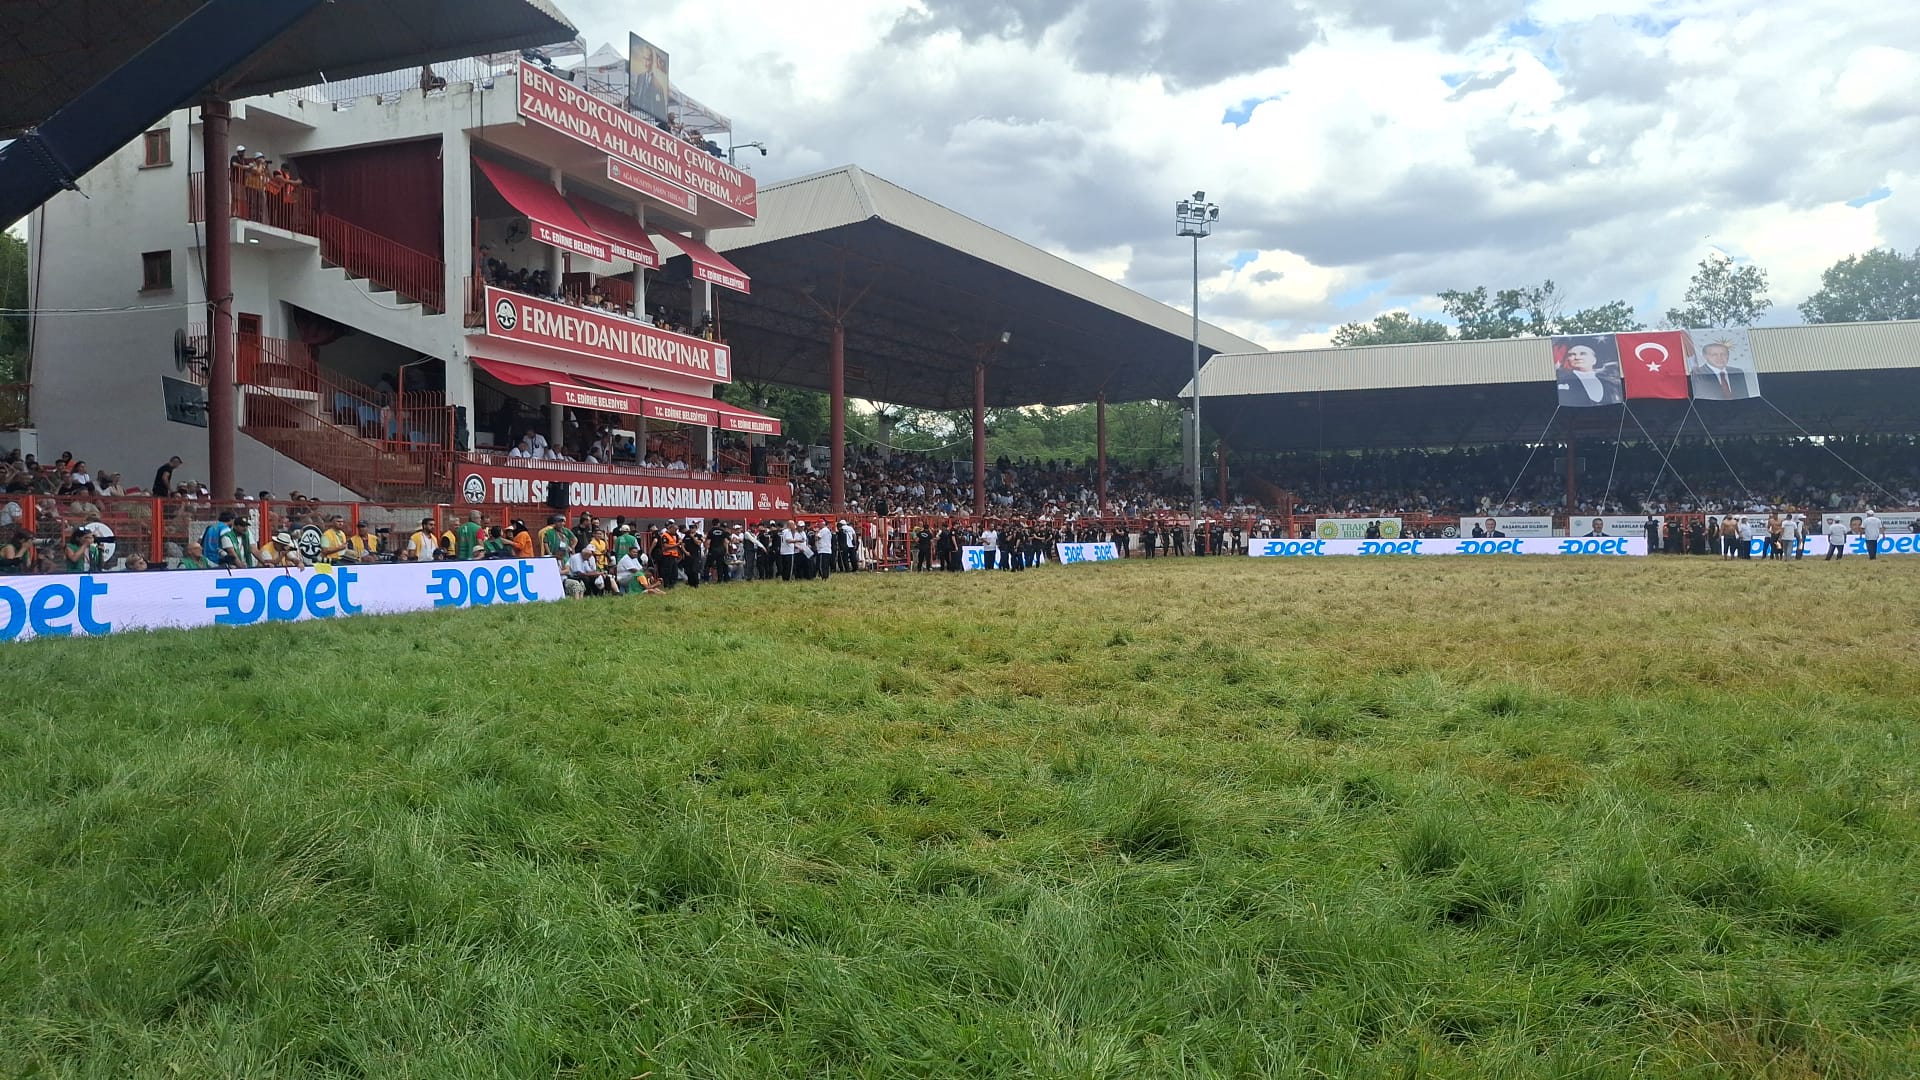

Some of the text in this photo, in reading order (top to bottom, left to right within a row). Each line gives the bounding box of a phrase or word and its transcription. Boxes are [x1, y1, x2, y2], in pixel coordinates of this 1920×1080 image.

[523, 67, 742, 188] BEN SPORCUNUN ZEKİ, ÇEVİK AYNI
[523, 93, 733, 204] ZAMANDA AHLAKLISINI SEVERİM.
[539, 227, 605, 258] T.C. EDİRNE BELEDİYESİ
[611, 243, 653, 266] DİRNE BELEDİYESİ
[522, 305, 710, 371] ERMEYDANI KIRKPINAR
[565, 391, 629, 411] T.C. EDİRNE BELEDİYESİ
[655, 406, 708, 424] T.C. EDİRNE BELEDİYESİ
[491, 477, 529, 504] TÜM
[531, 479, 651, 508] SPCULARIMIZA
[652, 486, 713, 511] BAŞARILAR
[713, 489, 754, 511] DİLERİM
[1340, 523, 1368, 531] TRAK
